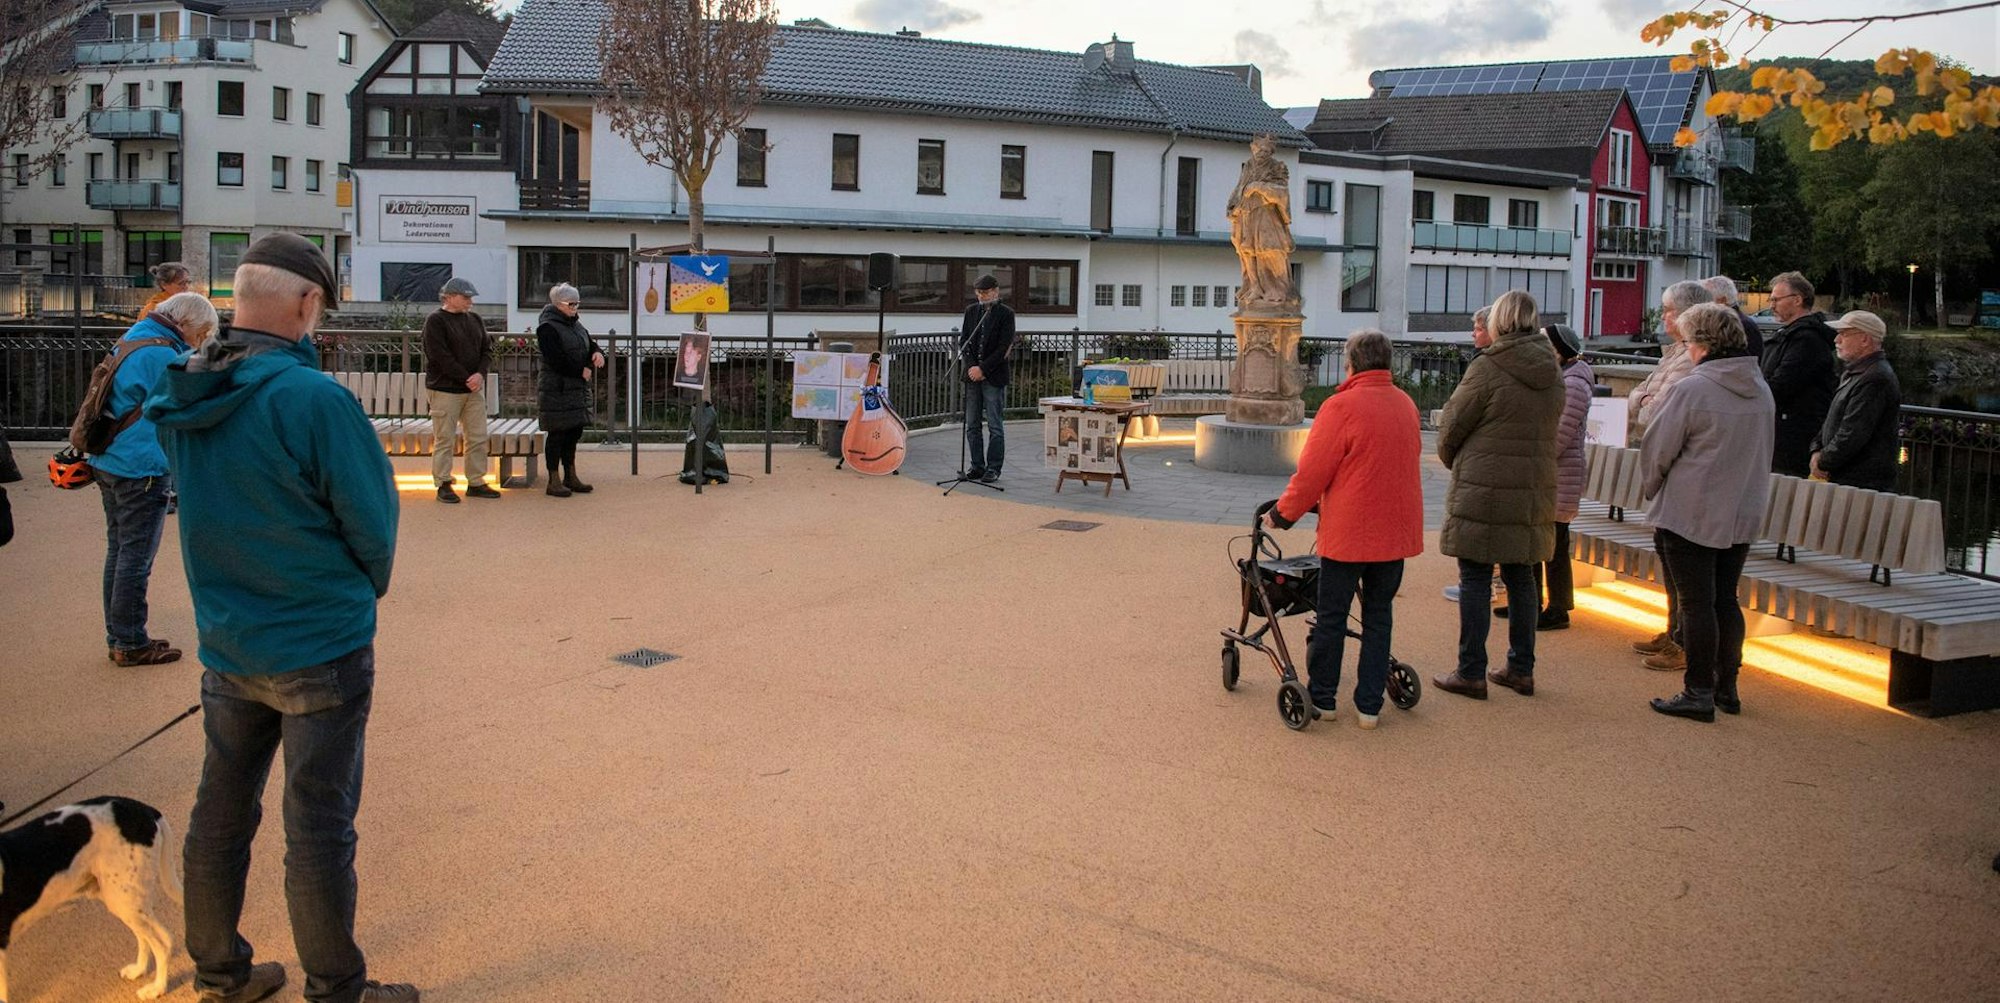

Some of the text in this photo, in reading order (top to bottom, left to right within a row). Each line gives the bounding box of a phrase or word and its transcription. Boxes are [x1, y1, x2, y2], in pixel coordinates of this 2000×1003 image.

[387, 200, 468, 217] Windhausen
[403, 221, 454, 229] Dekorationen
[405, 230, 450, 238] Lederwaren
